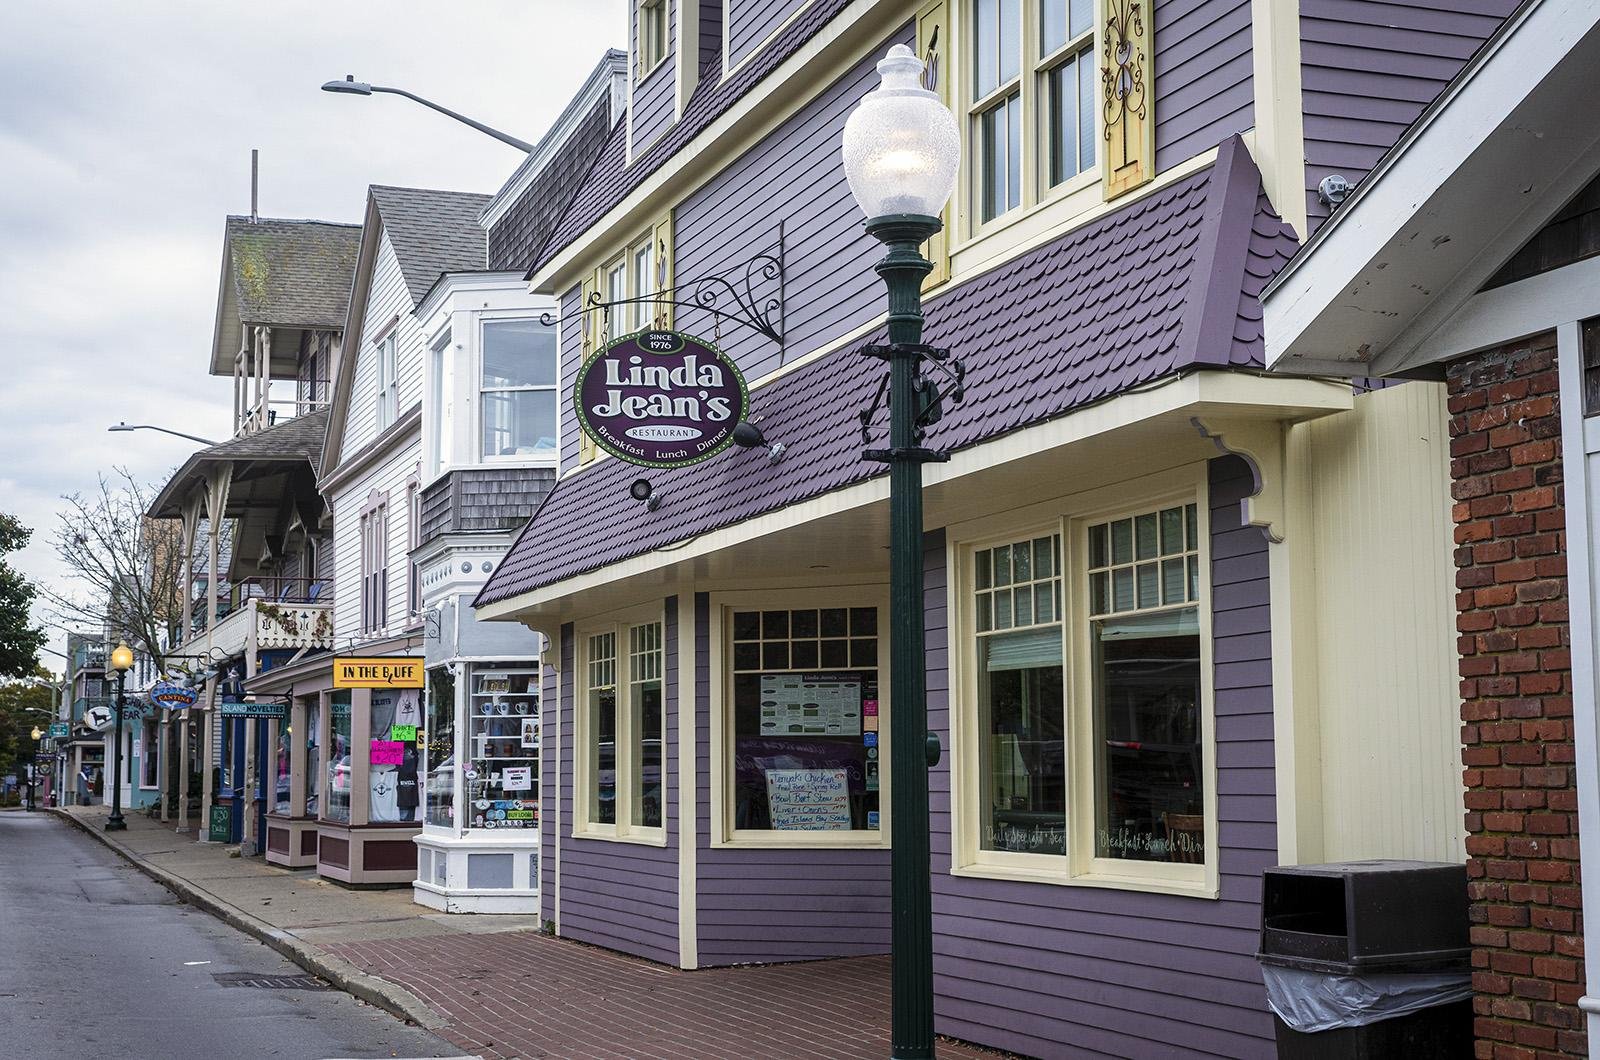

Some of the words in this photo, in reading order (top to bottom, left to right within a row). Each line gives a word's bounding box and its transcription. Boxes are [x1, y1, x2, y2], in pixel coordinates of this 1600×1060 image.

[650, 341, 672, 349] 1976
[605, 355, 724, 391] Linda
[592, 389, 732, 422] Jean's
[598, 425, 645, 457] Breakfast
[656, 449, 688, 459] Lunch
[696, 427, 728, 452] Dinner
[632, 428, 695, 437] RESTAURANT
[343, 666, 354, 678] IN
[358, 666, 378, 678] THE
[383, 666, 413, 684] BLUFF
[1099, 827, 1141, 858] Breakfast
